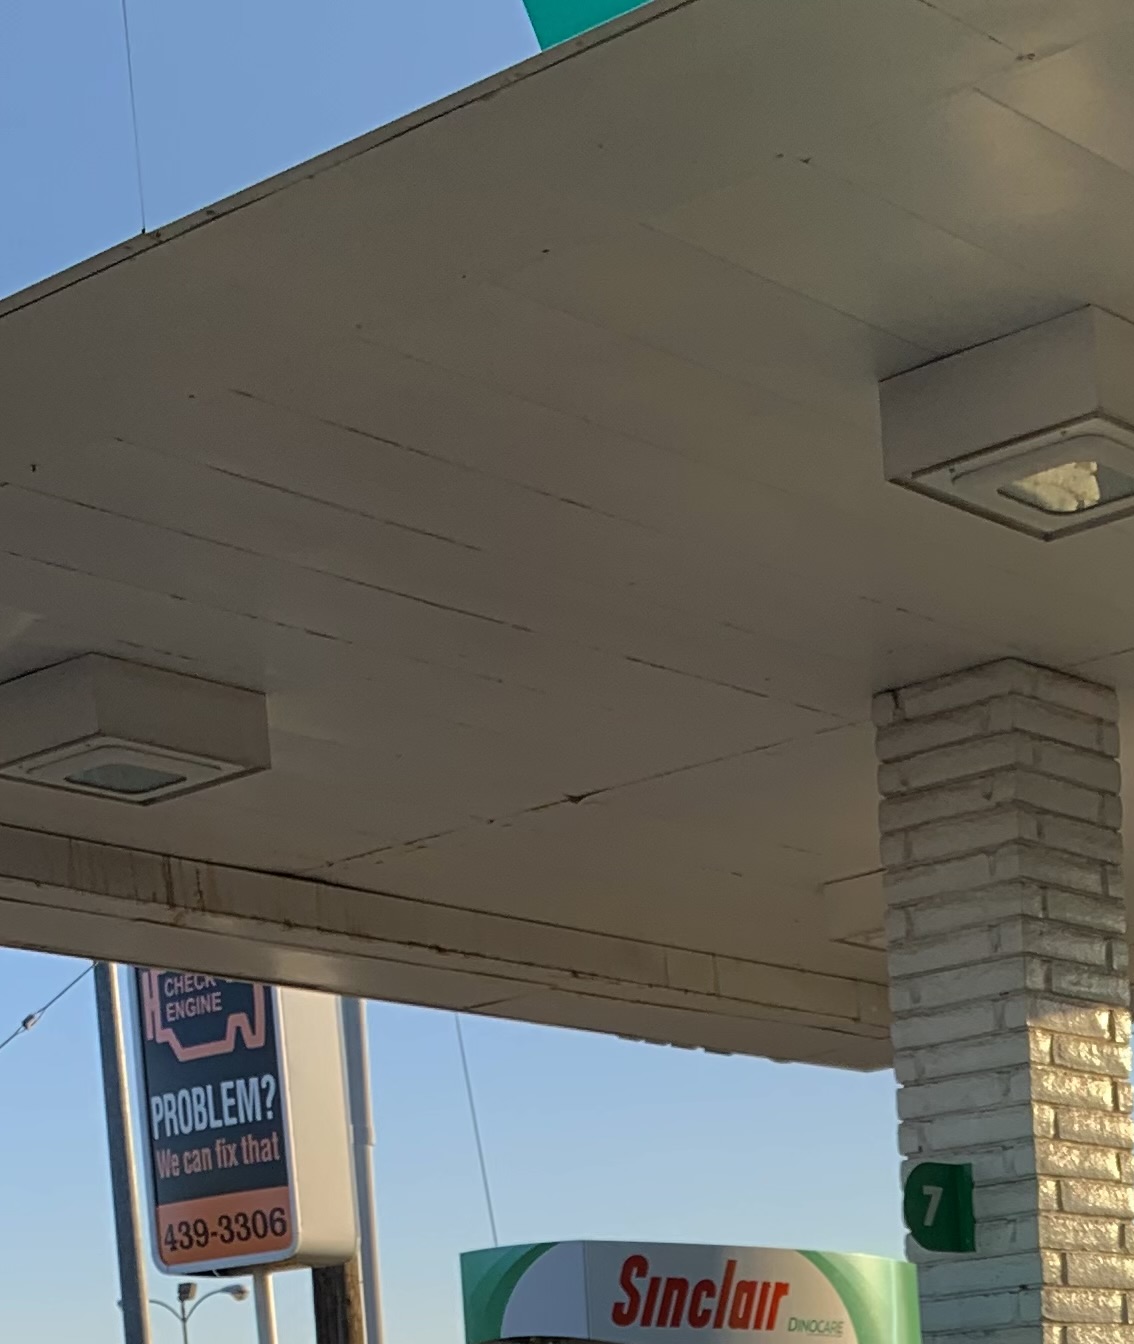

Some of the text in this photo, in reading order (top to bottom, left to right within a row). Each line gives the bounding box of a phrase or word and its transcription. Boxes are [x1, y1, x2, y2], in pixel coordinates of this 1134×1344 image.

[164, 973, 217, 997] CHECK
[166, 991, 223, 1022] ENGINE
[151, 1074, 276, 1140] PROBLEM?
[157, 1131, 280, 1179] We can fix that
[922, 1185, 944, 1227] 7
[164, 1207, 288, 1252] 439-3306
[611, 1253, 790, 1333] Sinclair
